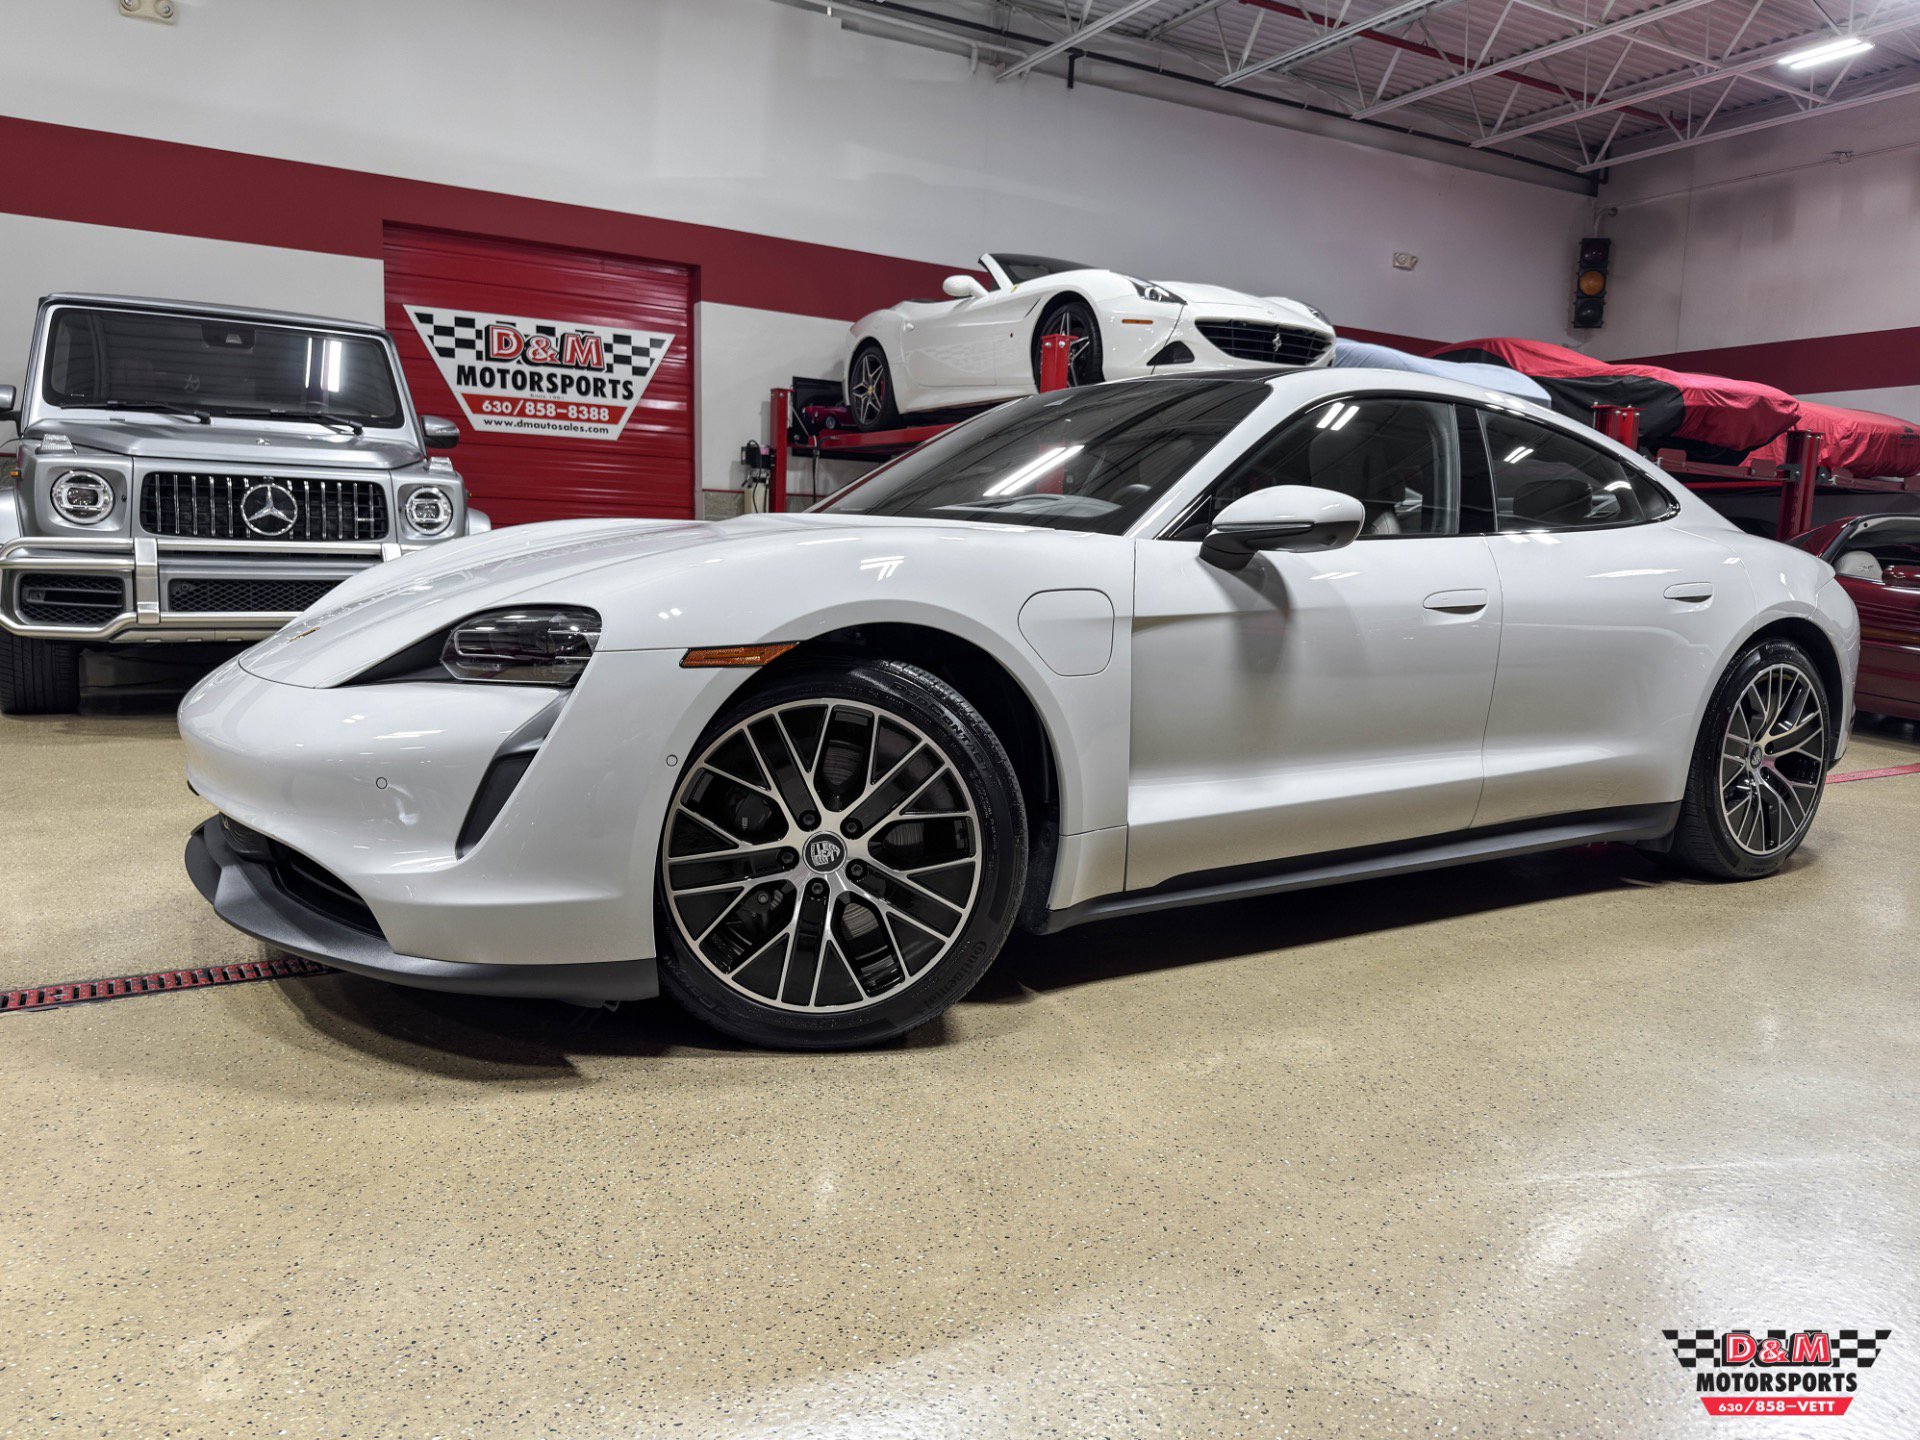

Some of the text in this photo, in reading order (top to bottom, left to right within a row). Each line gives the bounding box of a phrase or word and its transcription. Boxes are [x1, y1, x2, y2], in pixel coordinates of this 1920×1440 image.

[484, 323, 606, 373] D&M
[456, 364, 635, 401] MOTORSPORTS
[481, 399, 610, 422] 630/858-8388
[483, 416, 610, 435] www.dmautosales.com
